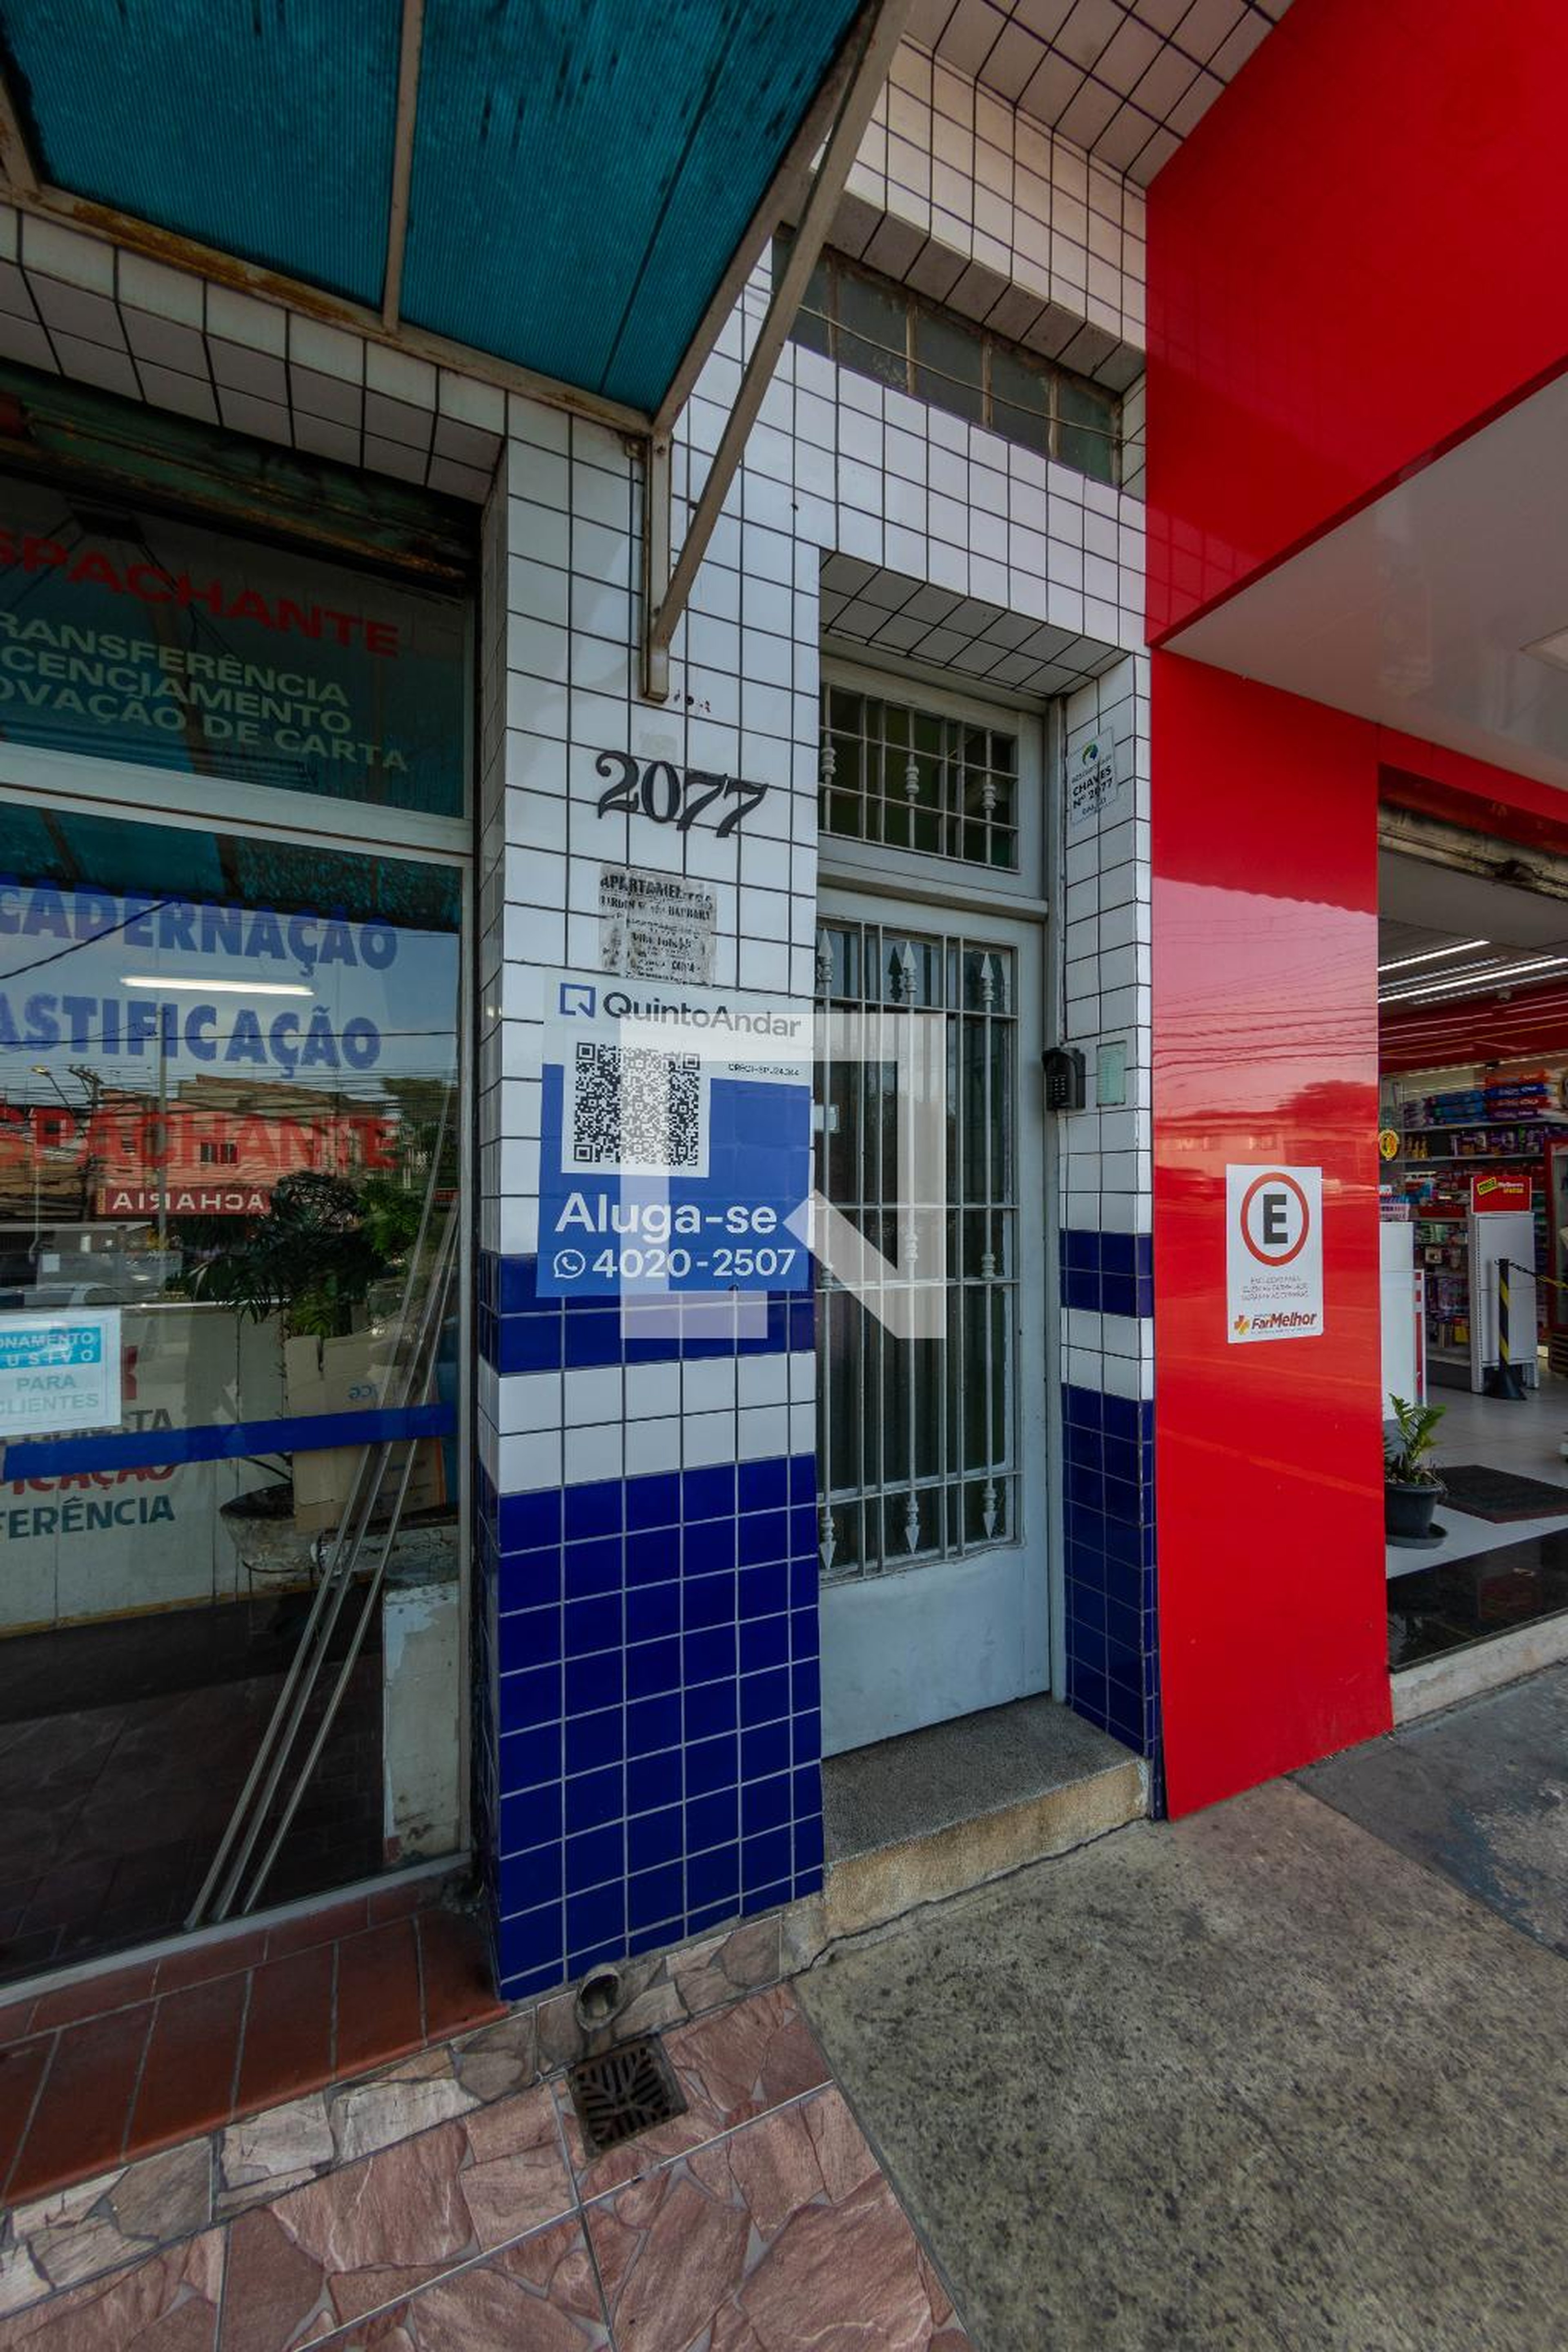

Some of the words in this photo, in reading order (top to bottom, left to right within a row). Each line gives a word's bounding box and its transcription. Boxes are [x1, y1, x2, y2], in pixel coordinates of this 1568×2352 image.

[204, 715, 261, 746] DE
[275, 729, 408, 773] CARTA
[596, 750, 769, 838] 2077
[1073, 765, 1111, 796] CHAVES
[603, 992, 801, 1037] QuintoAndar
[555, 1192, 777, 1243] Aluga-se
[1263, 1194, 1288, 1244] E
[1252, 1312, 1317, 1330] FarMelhor
[16, 1374, 76, 1392] PARA
